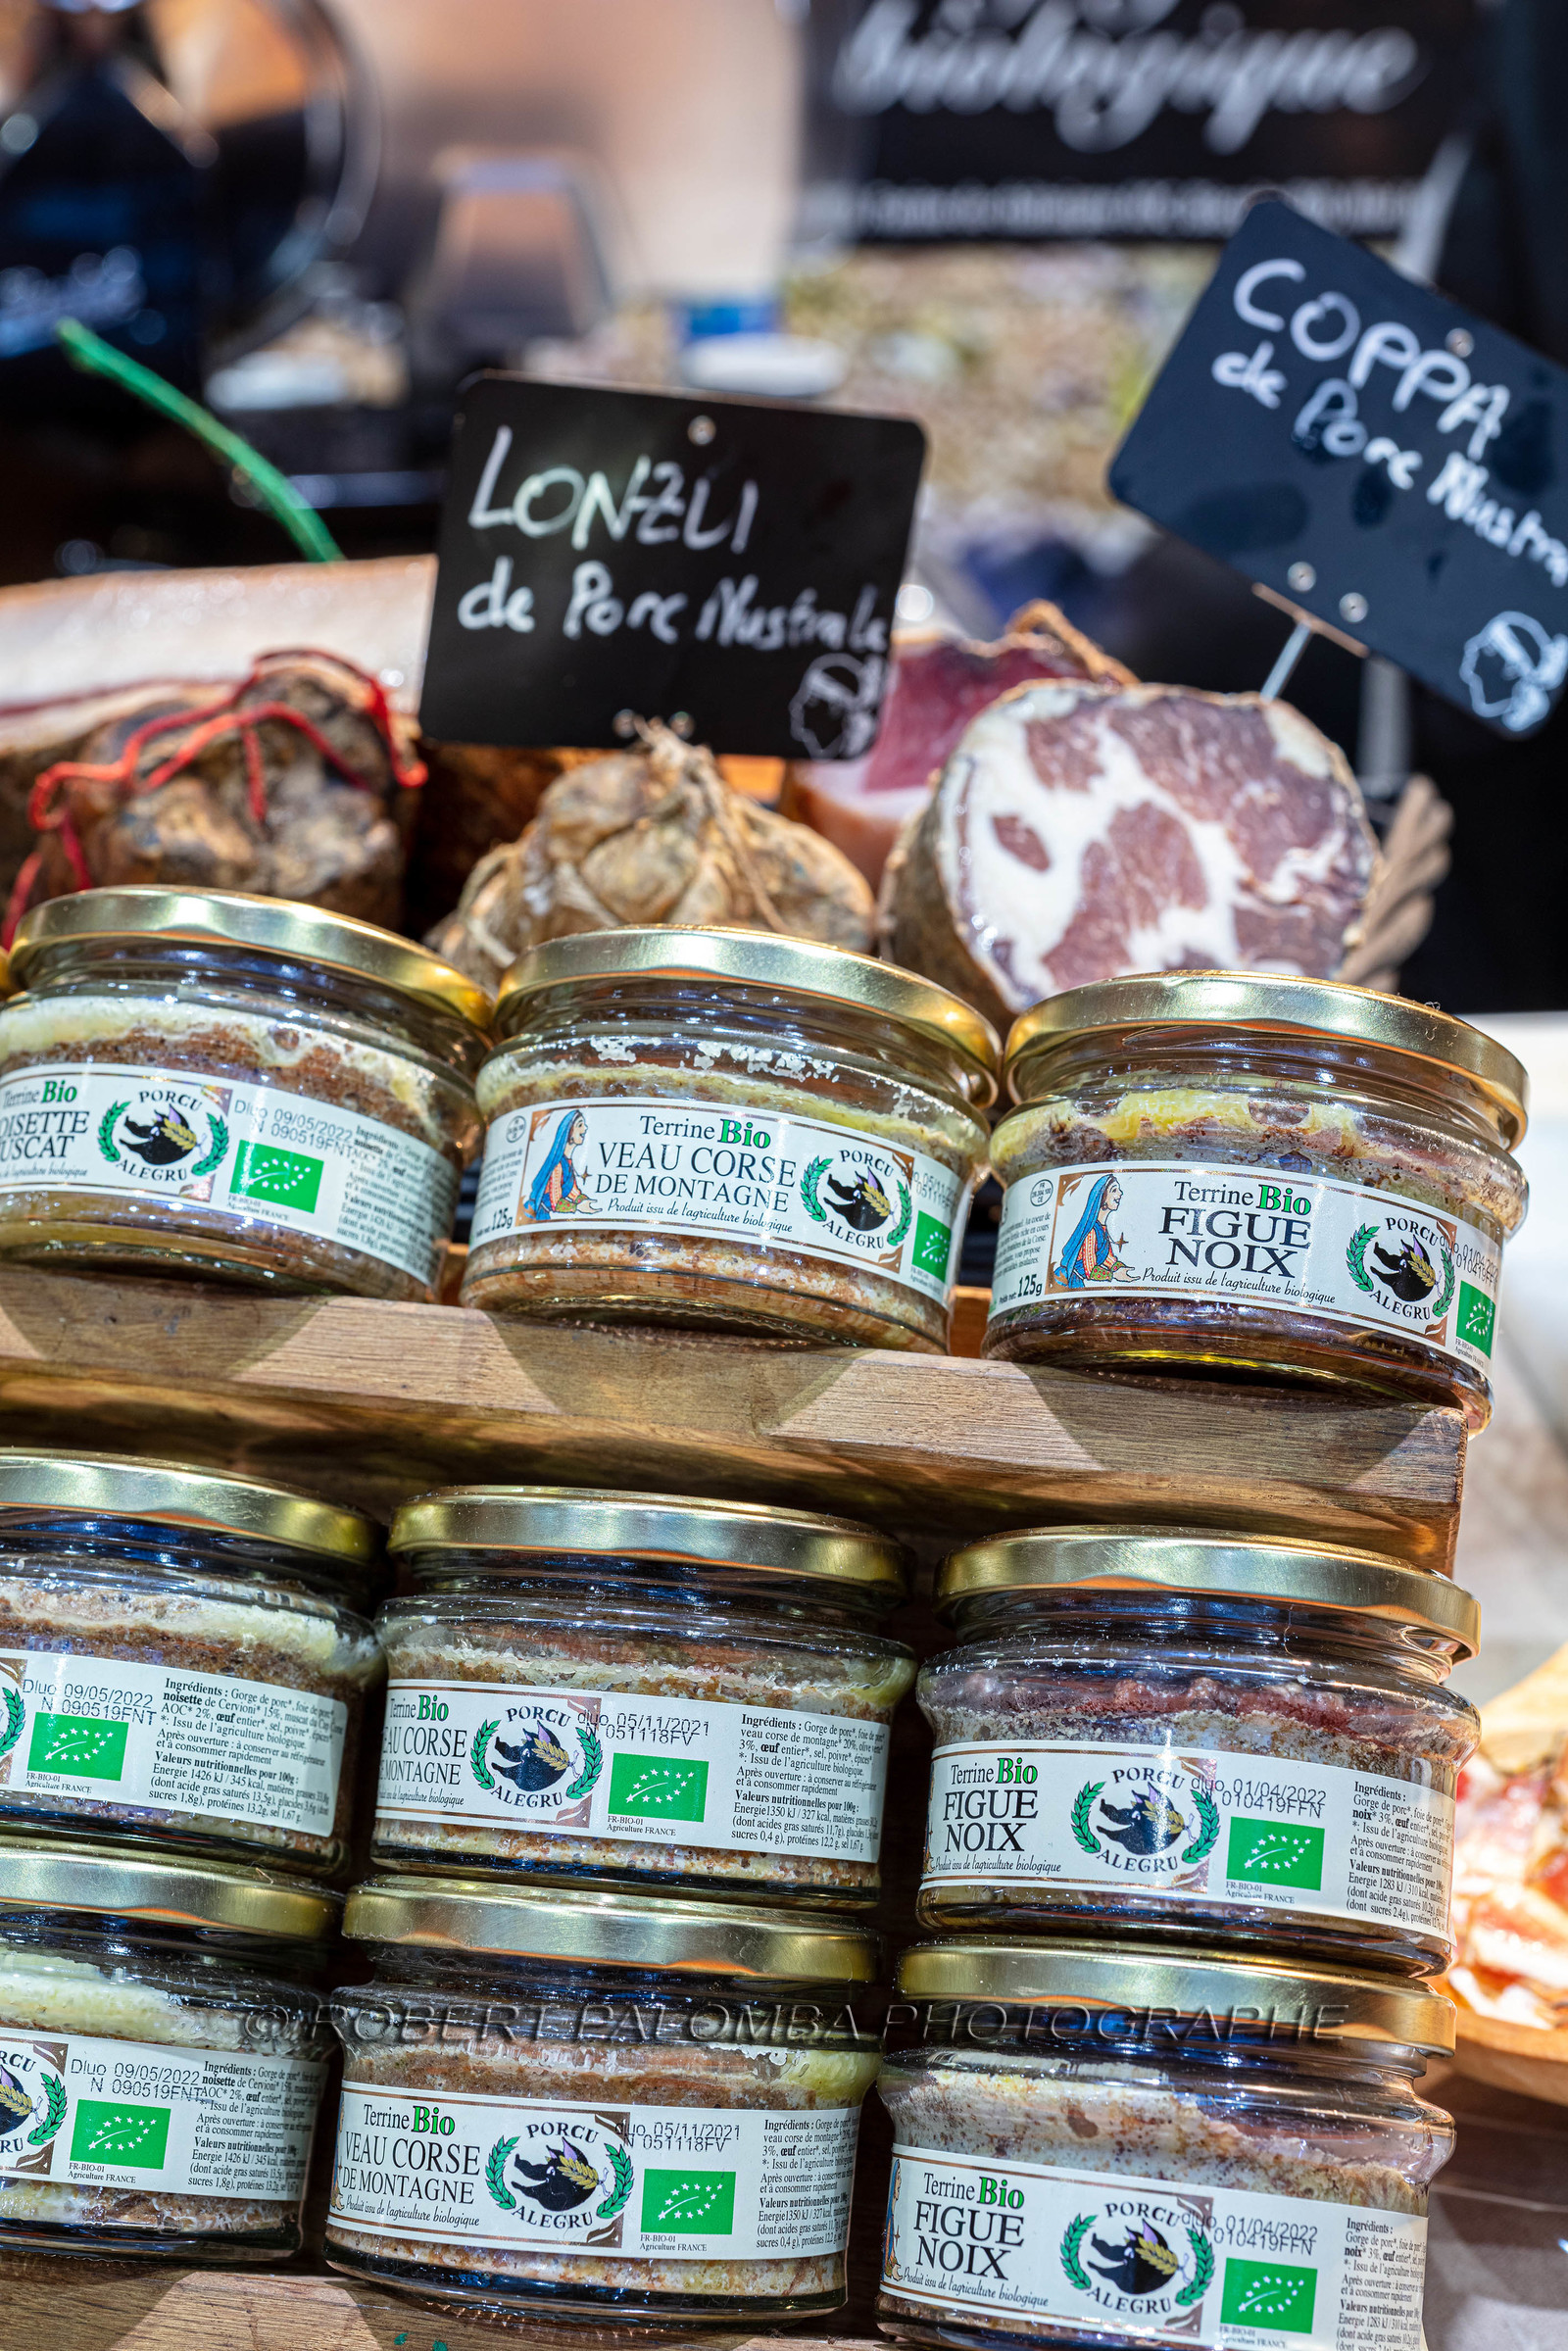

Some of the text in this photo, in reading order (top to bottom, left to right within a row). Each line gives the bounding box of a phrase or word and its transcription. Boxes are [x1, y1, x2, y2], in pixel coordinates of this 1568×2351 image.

[1234, 258, 1510, 461] COPPA
[1211, 339, 1288, 409] de
[1293, 377, 1423, 490] Porc
[458, 555, 536, 633] de
[563, 560, 687, 645] Porc
[41, 1080, 77, 1103] Bio
[138, 1090, 203, 1112] PORCU
[273, 1108, 353, 1143] 09/05/2022
[640, 1115, 771, 1149] Terrine Bio
[116, 1157, 188, 1183] ALEGRU
[599, 1142, 797, 1189] VEAU CORSE
[839, 1150, 895, 1177] PORCU
[596, 1174, 789, 1213] DE MONTAGNE
[1174, 1181, 1311, 1215] Terrine Bio
[491, 1207, 513, 1230] 125g
[608, 1198, 793, 1234] Produit issu de l'agriculture biologique
[1158, 1206, 1311, 1249] FIGUE
[822, 1220, 885, 1249] ALEGRU
[1386, 1217, 1438, 1247] PORCU
[1165, 1238, 1298, 1278] NOIX
[1018, 1273, 1043, 1298] 125g
[1142, 1267, 1336, 1303] Produit issu de l'agriculture biologique
[1369, 1288, 1431, 1320] ALEGRU
[22, 1679, 153, 1709] Dluo 09/05/2022
[163, 1691, 203, 1705] noisette
[204, 1696, 216, 1707] de
[165, 1678, 258, 1704] Ingrédients Gorge
[41, 1696, 157, 1726] N 090519FNT
[416, 1694, 449, 1722] Bio
[505, 1705, 571, 1728] PORCU
[606, 1724, 694, 1746] 051118FV
[617, 1713, 710, 1736] 05/11/2021
[741, 1729, 762, 1739] veau
[765, 1732, 788, 1741] corse
[790, 1732, 801, 1742] de
[742, 1714, 837, 1735] Ingrédients Gorge de
[404, 1726, 467, 1758] CORSE
[739, 1739, 779, 1754] 3%, œuf
[25, 1772, 61, 1782] FR-BIO-01
[385, 1760, 462, 1785] MONTAGNE
[951, 1757, 1038, 1785] Terrine Bio
[1111, 1767, 1186, 1789] PORCU
[24, 1780, 92, 1794] Agriculture FRANCE
[428, 1788, 464, 1808] biologique
[491, 1785, 564, 1808] ALEGRU
[1233, 1779, 1327, 1805] 01/04/2022
[1354, 1782, 1401, 1801] Ingrédients
[943, 1789, 1039, 1821] FIGUE
[1222, 1790, 1322, 1818] 010419FFN
[607, 1824, 676, 1837] Agriculture FRANCE
[608, 1816, 643, 1825] FR-BIO-01
[945, 1823, 1027, 1852] NOIX
[935, 1854, 1061, 1876] Produit issu de l'agriculture biologique
[1097, 1849, 1178, 1873] ALEGRU
[1225, 1890, 1295, 1904] Agriculture FRANCE
[1226, 1882, 1262, 1891] FR-BIO-01
[71, 2058, 200, 2085] Dluo 09/05/2022
[202, 2075, 235, 2087] noisette
[204, 2061, 252, 2076] Ingrédients
[90, 2078, 203, 2102] N 090519FNT
[364, 2104, 456, 2136] Terrine Bio
[525, 2122, 600, 2144] PORCU
[654, 2122, 740, 2140] 05/11/2021
[764, 2119, 809, 2132] Ingrédients
[345, 2131, 480, 2176] VEAU CORSE
[643, 2134, 726, 2152] 051118FV
[68, 2171, 136, 2183] Agriculture FRANCE
[69, 2162, 105, 2173] FR-BIO-01
[342, 2166, 474, 2205] DE MONTAGNE
[924, 2172, 1024, 2210] Terrine Bio
[346, 2194, 479, 2229] Produit issu de l'agriculture biologique
[512, 2205, 593, 2229] ALEGRU
[913, 2200, 1024, 2247] FIGUE
[1104, 2202, 1181, 2228] PORCU
[640, 2234, 676, 2243] FR-BIO-01
[1226, 2215, 1318, 2242] 01/04/2022
[639, 2242, 708, 2252] Agriculture FRANCE
[1214, 2228, 1313, 2256] 010419FFN
[915, 2234, 1011, 2281] NOIX
[903, 2266, 1049, 2308] Produit issu de l'agriculture biologique
[1087, 2286, 1171, 2315] ALEGRU
